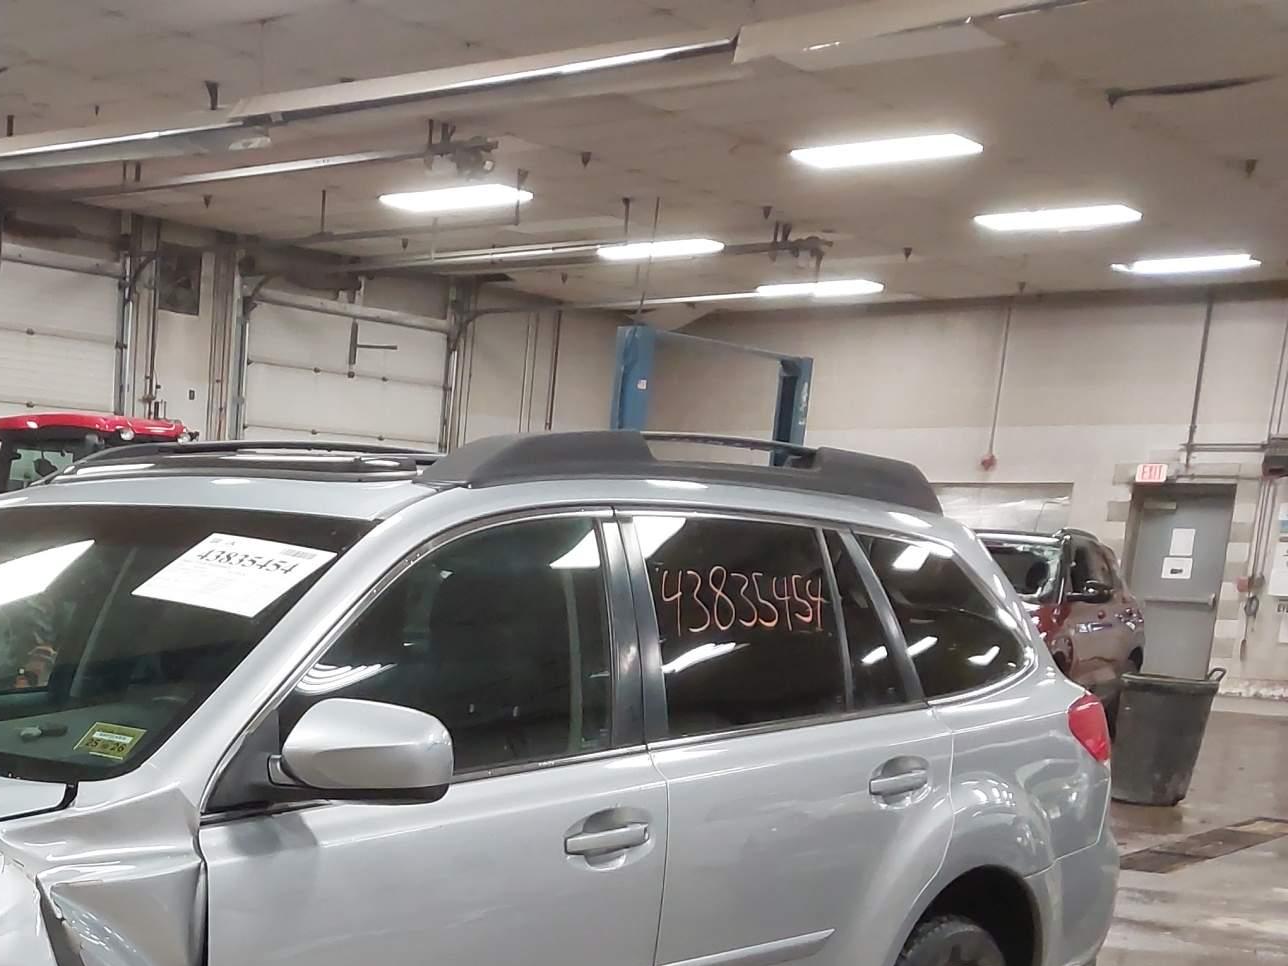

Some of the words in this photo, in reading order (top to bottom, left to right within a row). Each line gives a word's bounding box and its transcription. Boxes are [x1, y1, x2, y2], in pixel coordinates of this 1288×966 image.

[1141, 464, 1162, 481] EXIT
[196, 549, 299, 575] 43835454
[662, 566, 826, 637] 43835454
